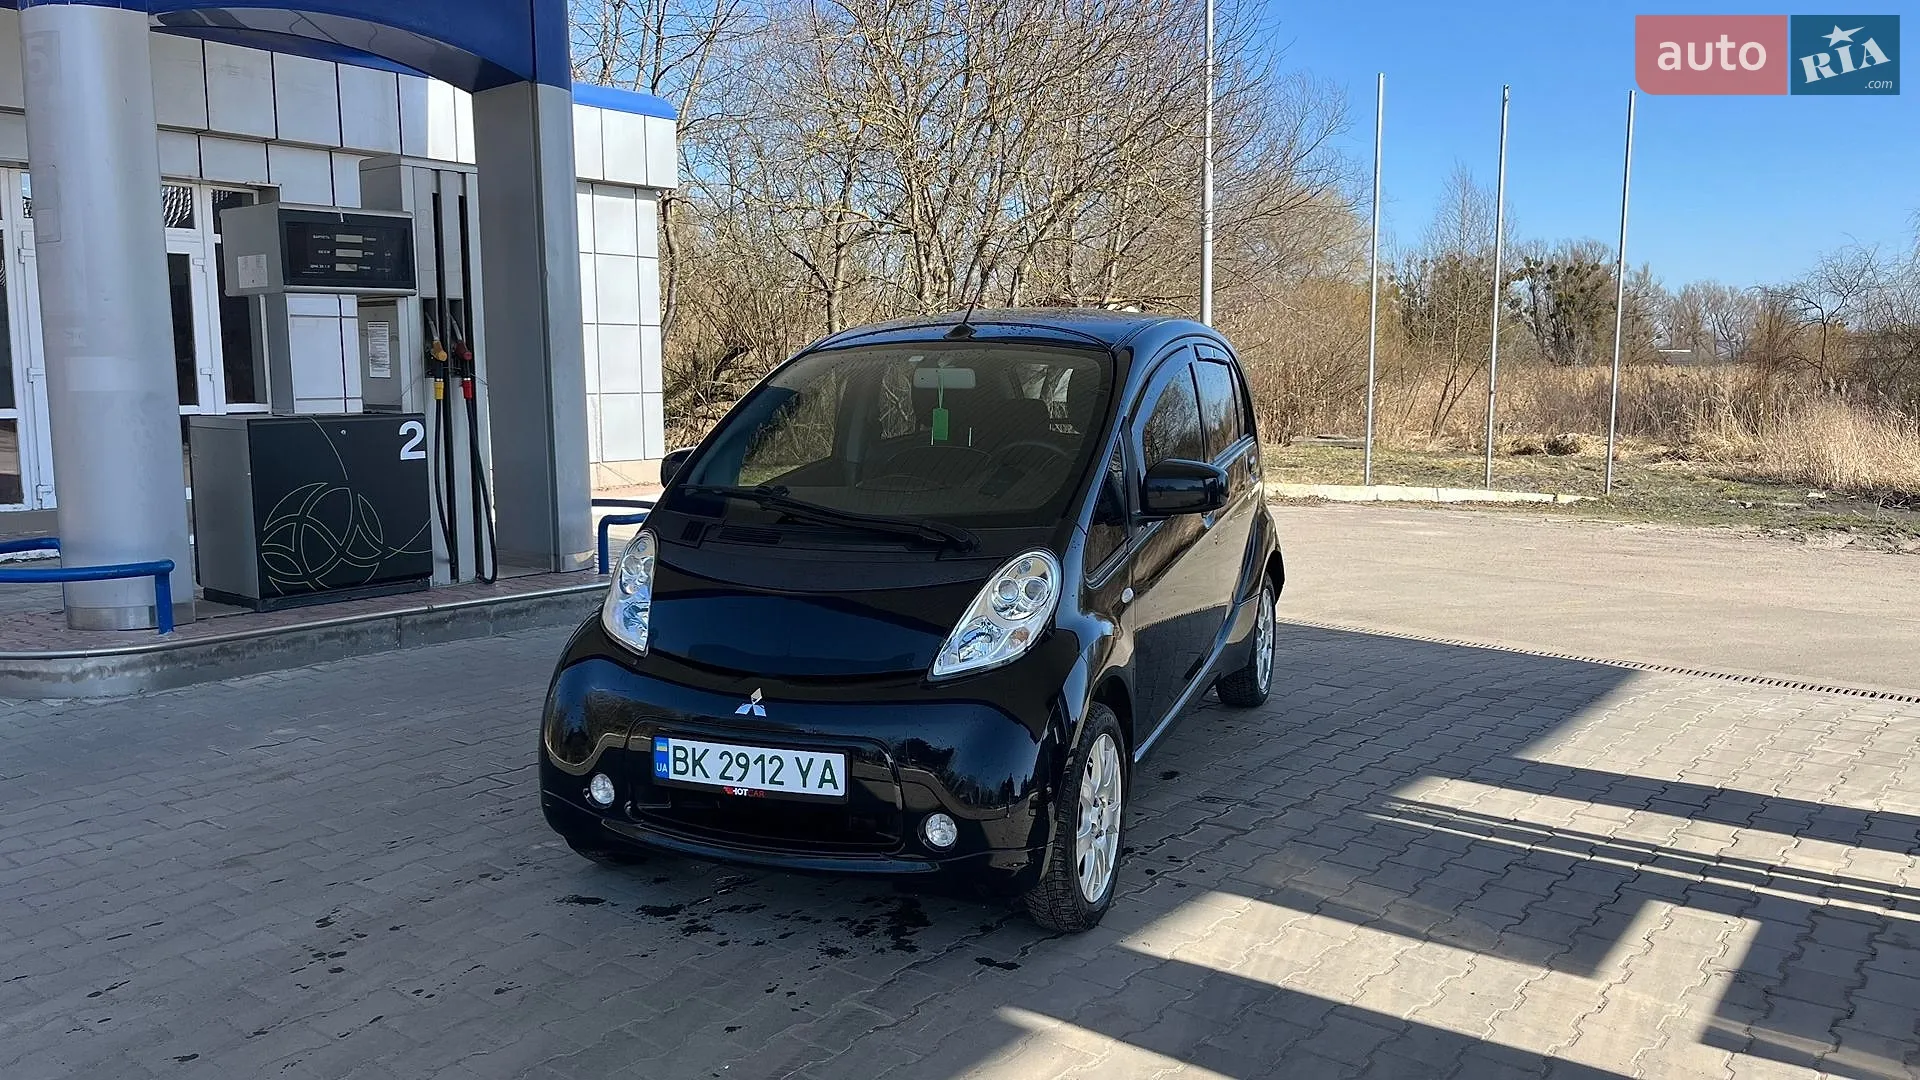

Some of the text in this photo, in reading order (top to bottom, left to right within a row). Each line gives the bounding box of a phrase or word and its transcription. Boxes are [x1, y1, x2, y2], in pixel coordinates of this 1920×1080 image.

[399, 420, 426, 461] 2
[655, 762, 668, 773] UA
[672, 745, 839, 790] BK 2912 YA
